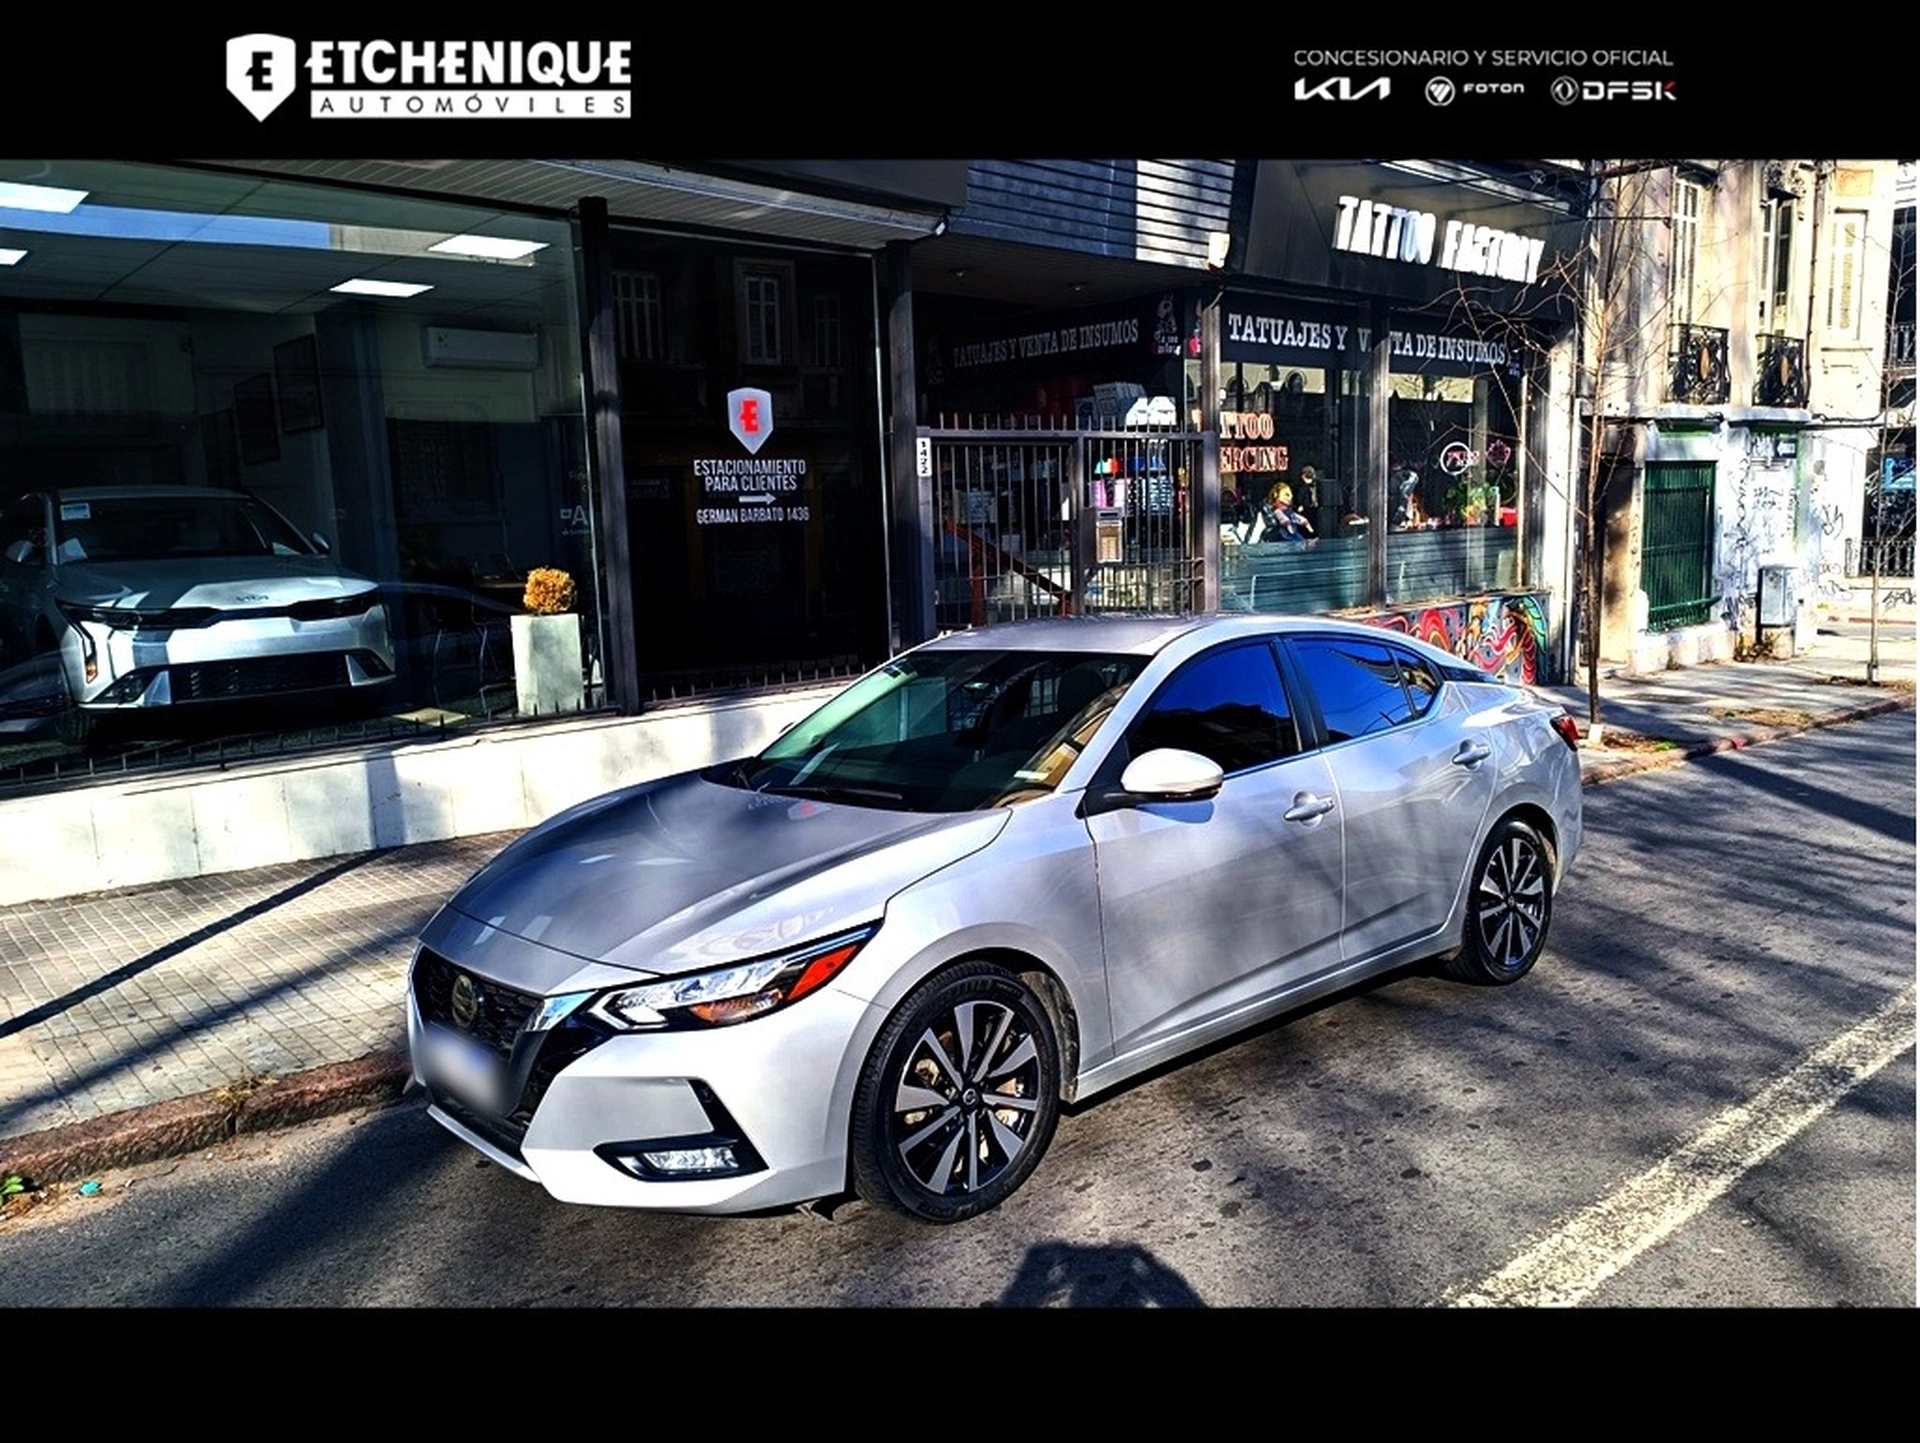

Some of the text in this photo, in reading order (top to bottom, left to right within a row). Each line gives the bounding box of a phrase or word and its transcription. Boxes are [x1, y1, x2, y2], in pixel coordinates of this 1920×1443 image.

[1333, 196, 1545, 284] TATTOO FACTORY
[953, 340, 1008, 368] TATUAJES
[1008, 339, 1018, 360] Y
[1018, 332, 1059, 359] VENTA
[1061, 327, 1077, 351] DE
[1079, 318, 1139, 349] INSUMOS
[1228, 313, 1331, 349] TATUAJES
[1335, 325, 1349, 351] Y
[1416, 333, 1437, 358] DE
[1437, 336, 1506, 364] INSUMOS
[693, 459, 806, 476] ESTACIONAMIENTO
[919, 440, 929, 475] 1422
[705, 475, 797, 492] PARA CLIENTES
[696, 506, 810, 525] GERMAN BARBATO 1436
